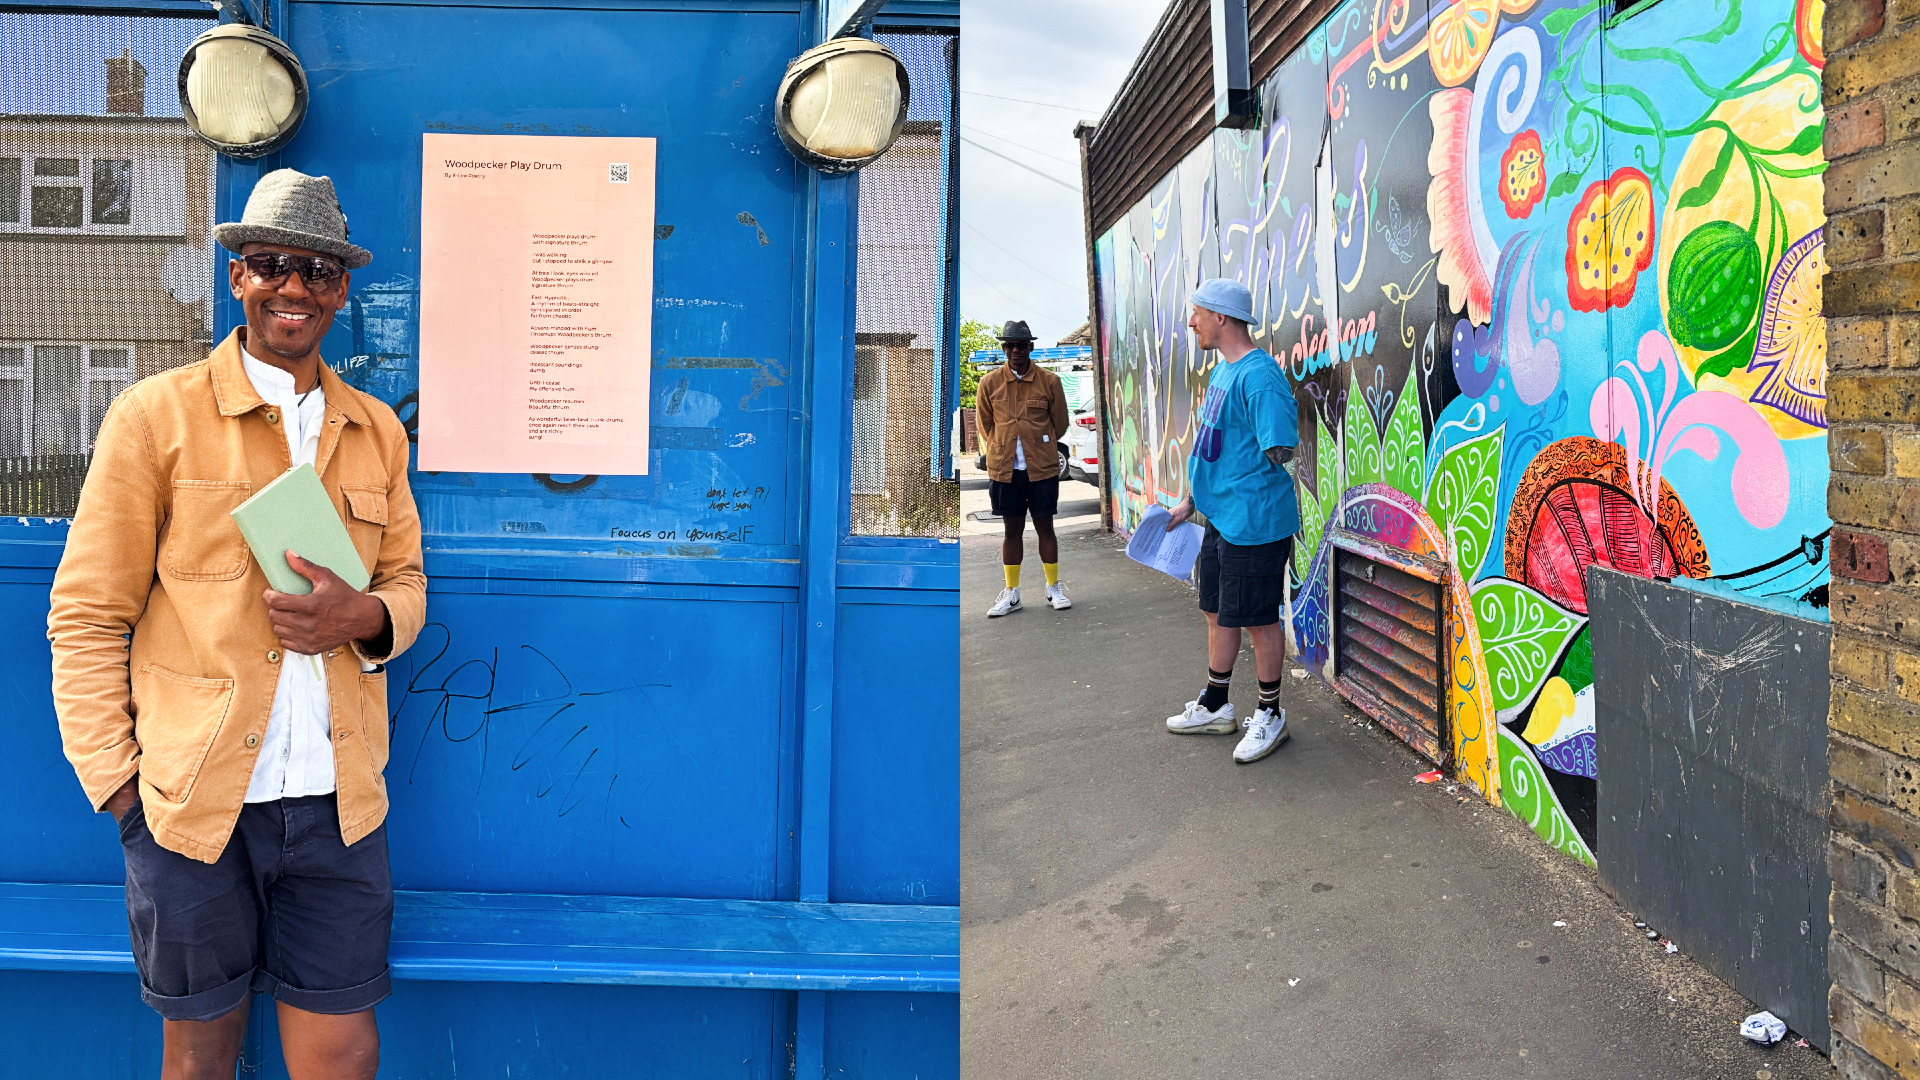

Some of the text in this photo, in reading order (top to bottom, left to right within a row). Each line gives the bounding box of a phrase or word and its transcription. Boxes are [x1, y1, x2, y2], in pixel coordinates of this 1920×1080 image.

[445, 160, 561, 171] Woodpecker Play Drum
[1291, 310, 1378, 382] Seaon
[657, 530, 676, 540] on
